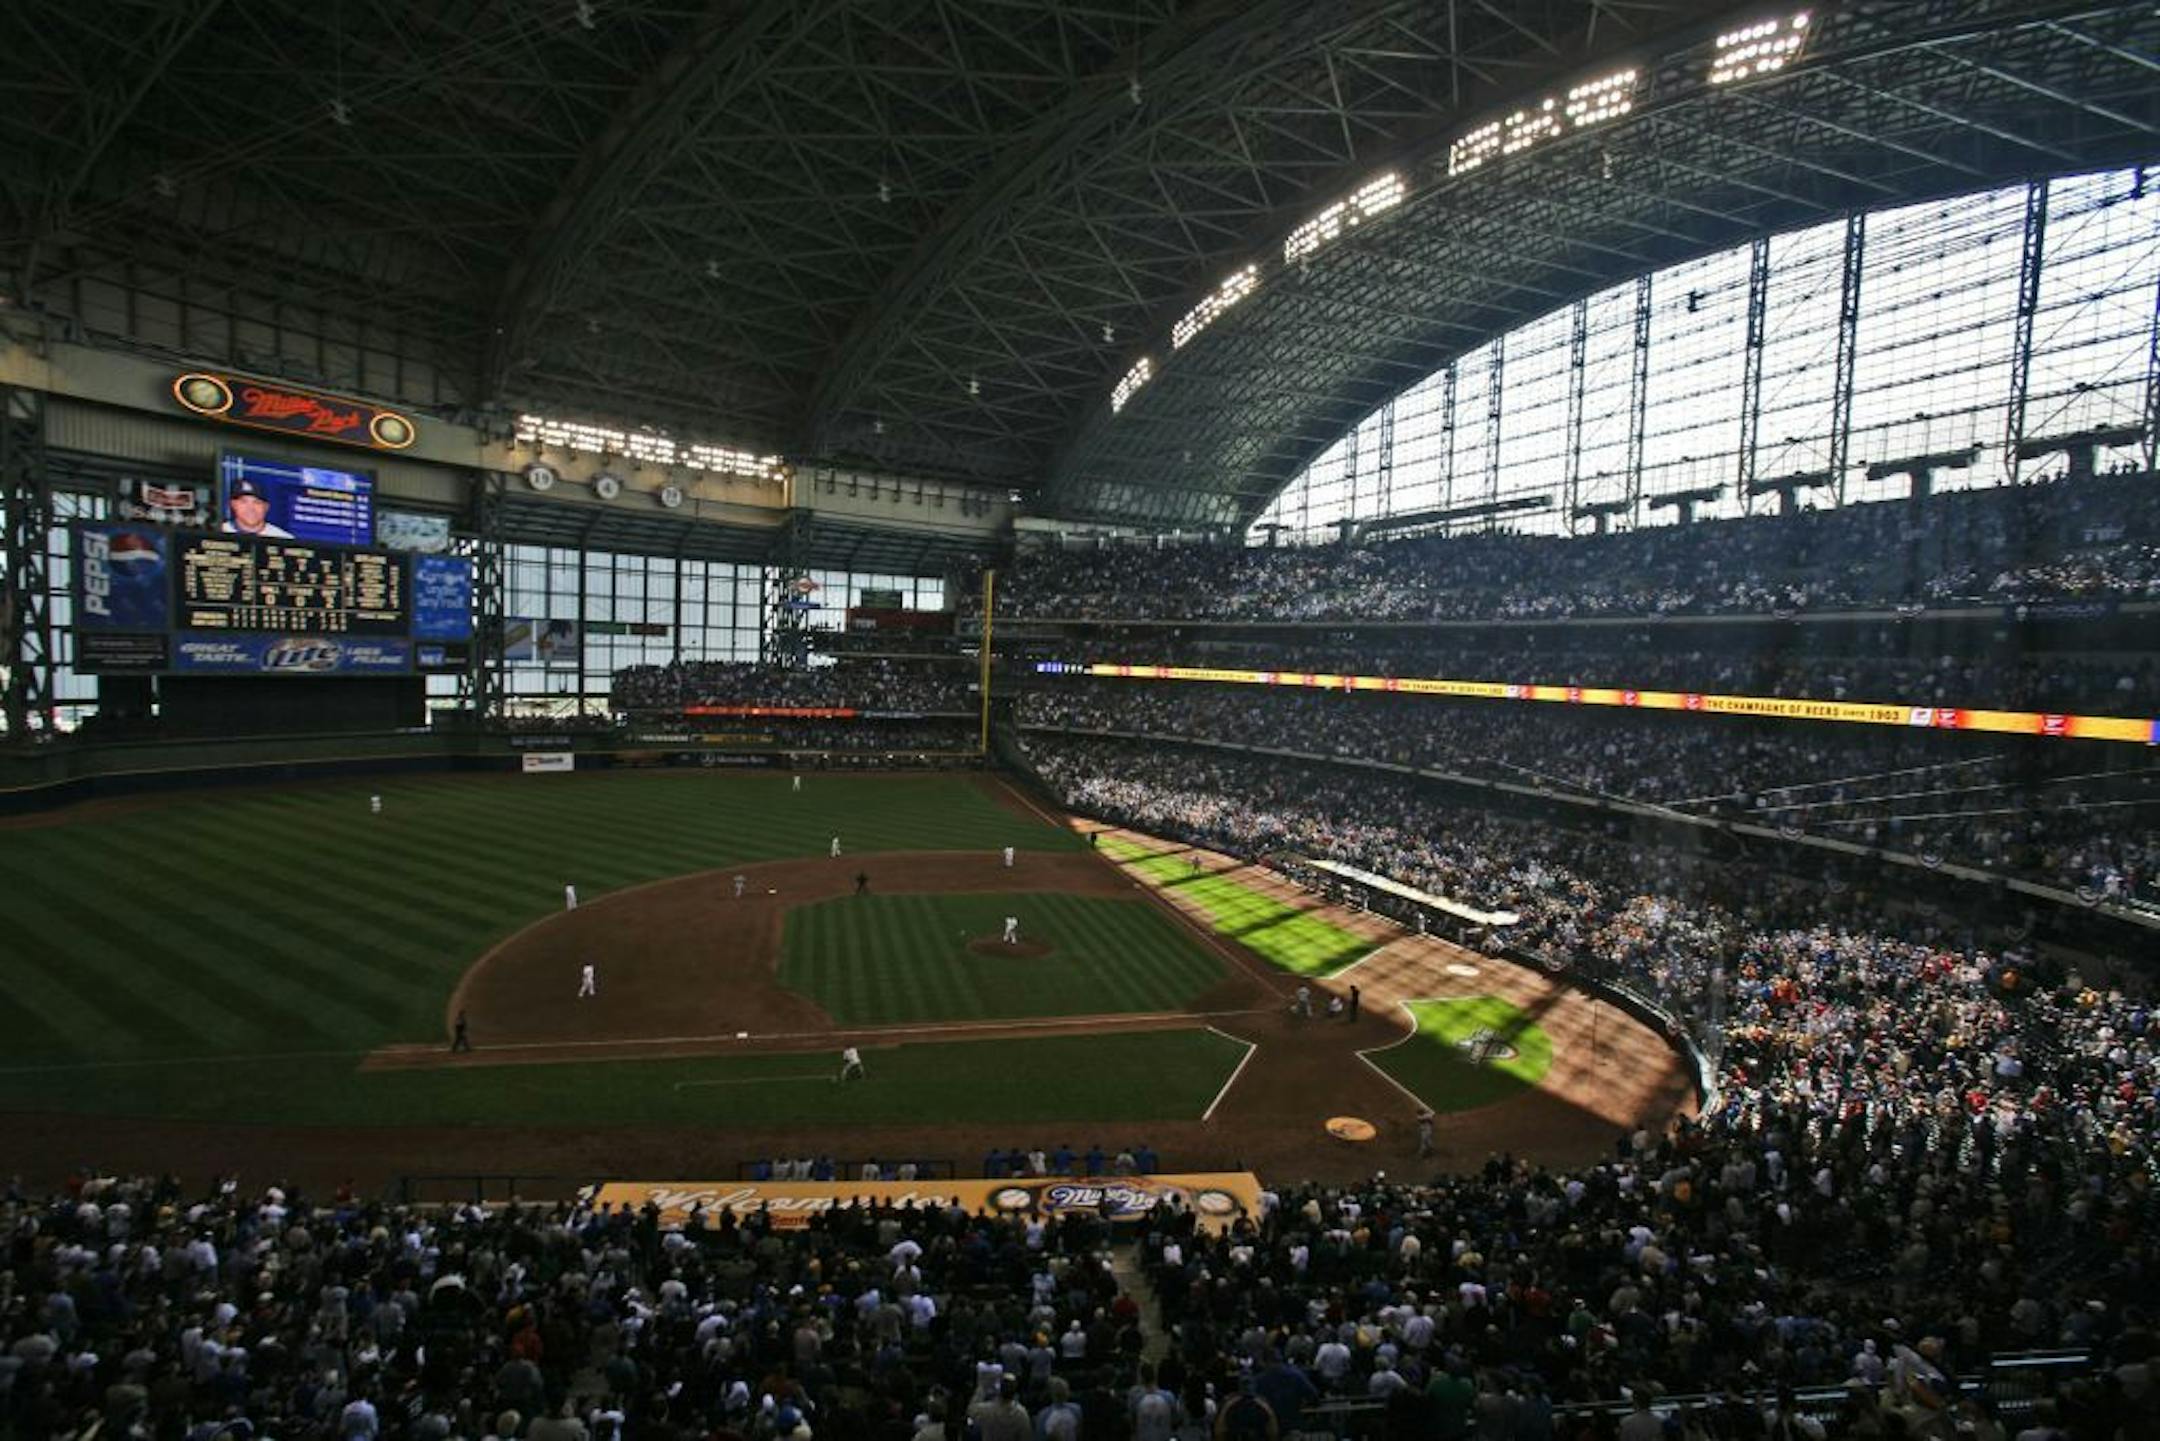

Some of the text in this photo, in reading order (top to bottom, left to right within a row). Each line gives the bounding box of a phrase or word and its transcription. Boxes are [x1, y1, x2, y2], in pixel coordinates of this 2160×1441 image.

[83, 531, 111, 616] PEPSI
[1707, 700, 1724, 709] THE
[1727, 701, 1785, 713] CHAMPAGNE
[1789, 703, 1801, 712] OF
[1805, 705, 1839, 715] BEERS
[1870, 711, 1899, 720] 1903
